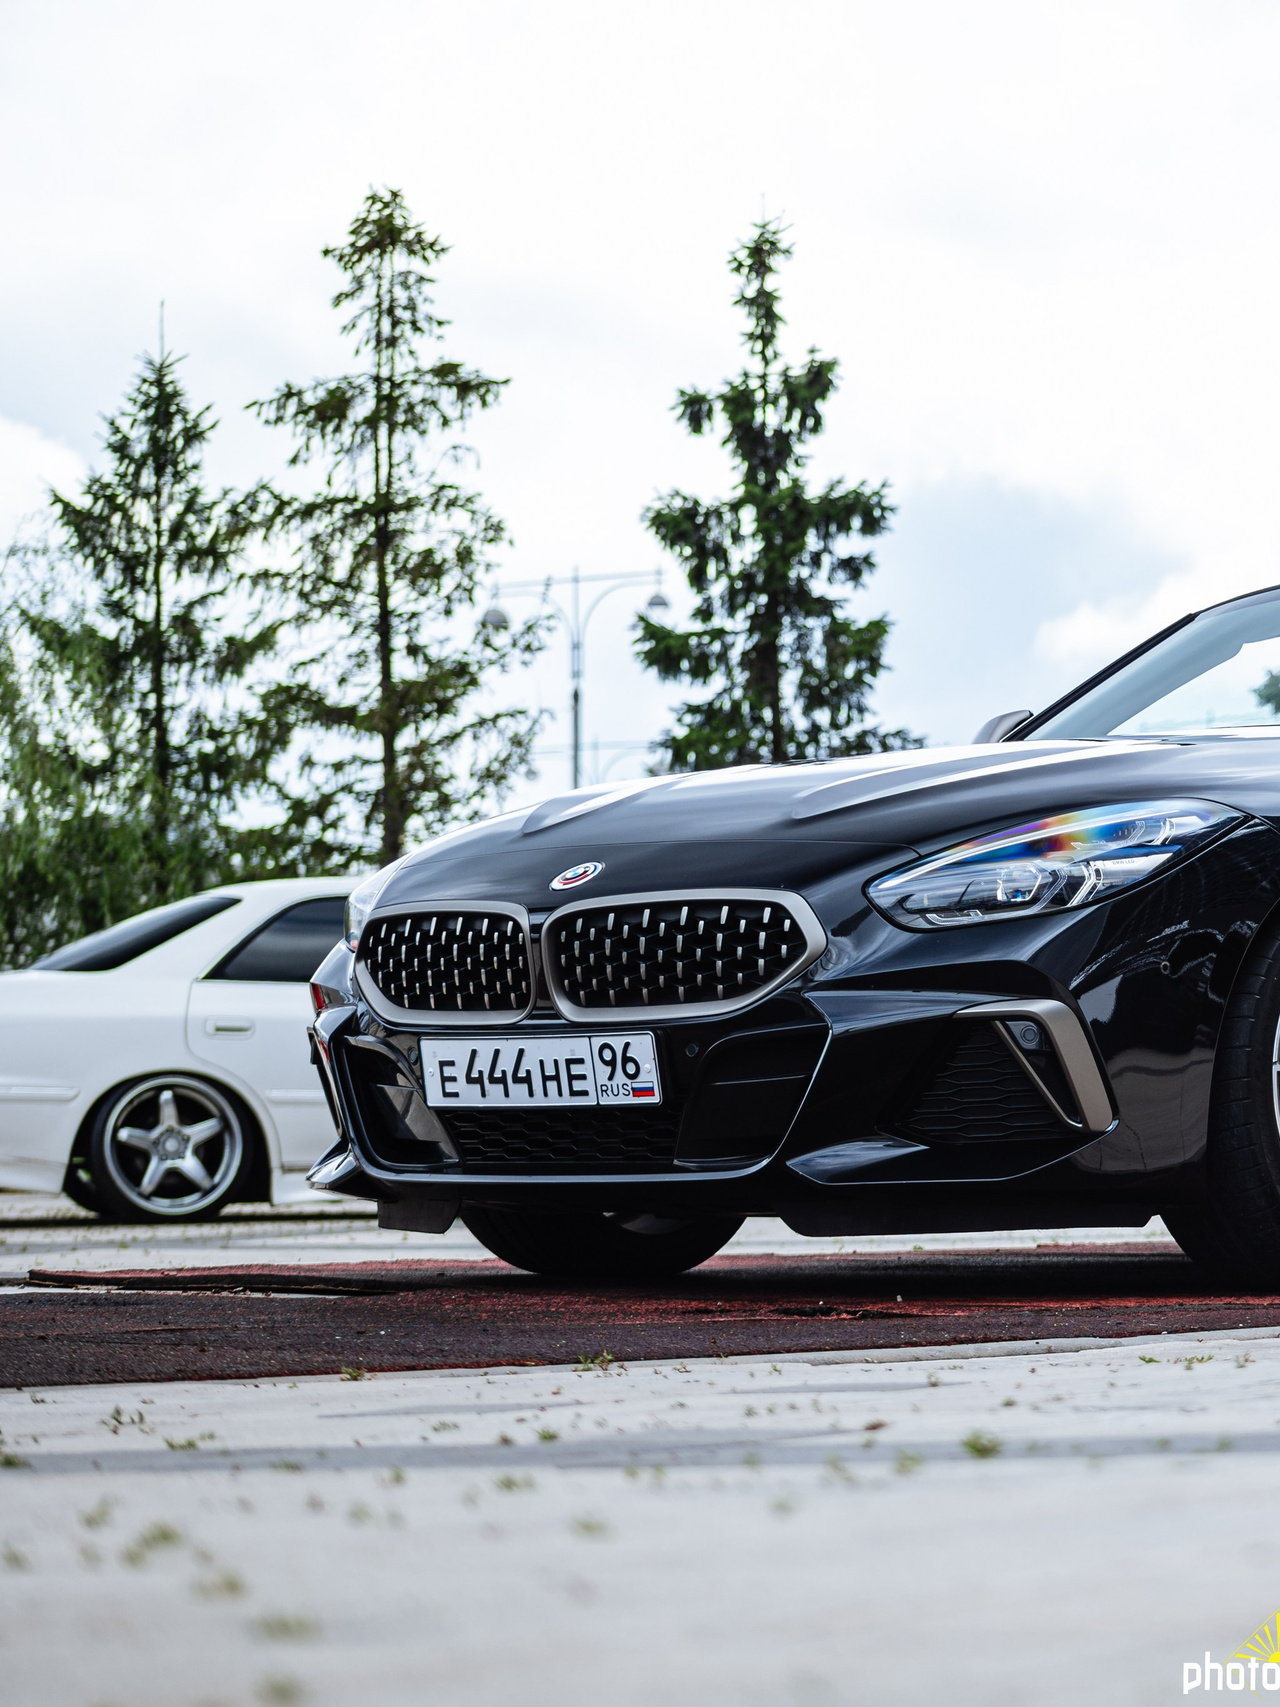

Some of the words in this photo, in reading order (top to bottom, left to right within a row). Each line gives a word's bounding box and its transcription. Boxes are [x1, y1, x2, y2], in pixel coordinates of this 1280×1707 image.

[438, 1047, 589, 1098] E444HE
[597, 1041, 641, 1081] 96
[600, 1082, 631, 1098] RUS
